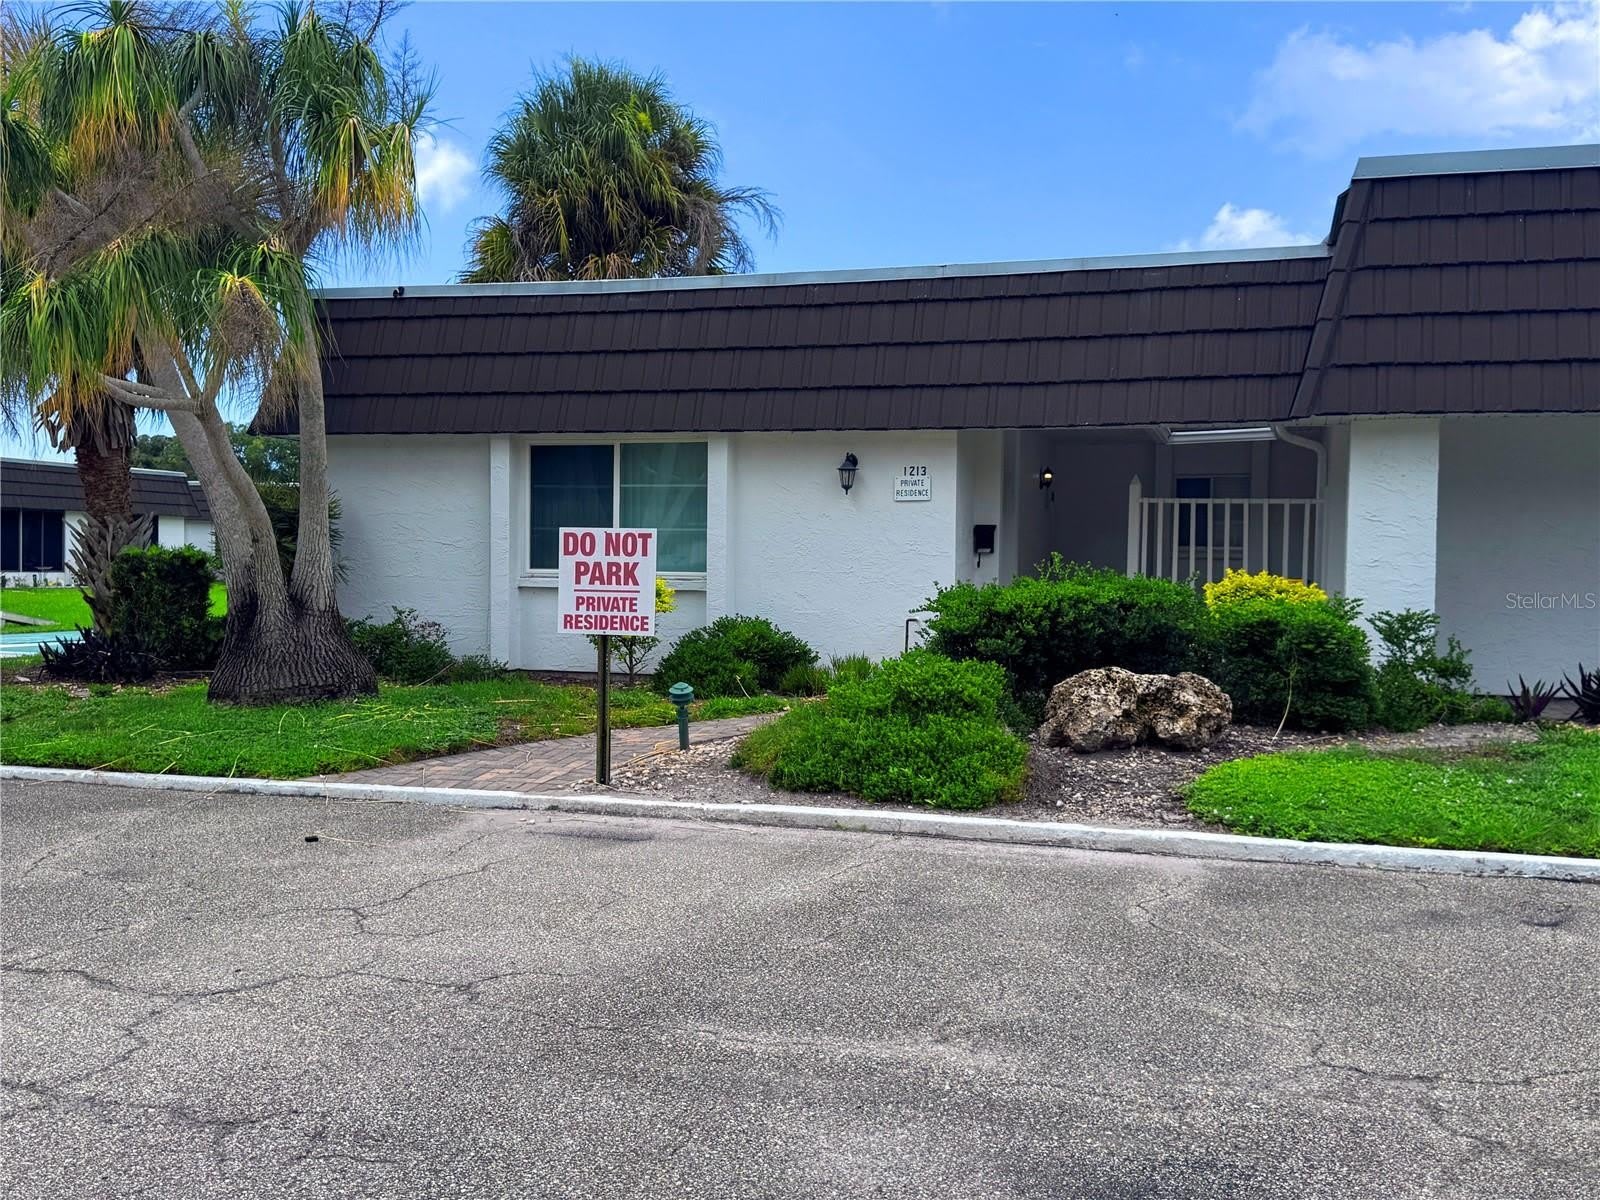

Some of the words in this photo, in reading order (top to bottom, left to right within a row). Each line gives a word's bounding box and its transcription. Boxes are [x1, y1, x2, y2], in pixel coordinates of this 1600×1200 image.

[904, 466, 927, 476] 1213
[900, 479, 924, 487] PRIVATE
[896, 489, 929, 497] RESIDENCE
[563, 532, 596, 556] DO
[604, 532, 652, 557] NOT
[574, 561, 640, 586] PARK
[575, 596, 638, 613] PRIVATE
[563, 614, 649, 632] RESIDENCE
